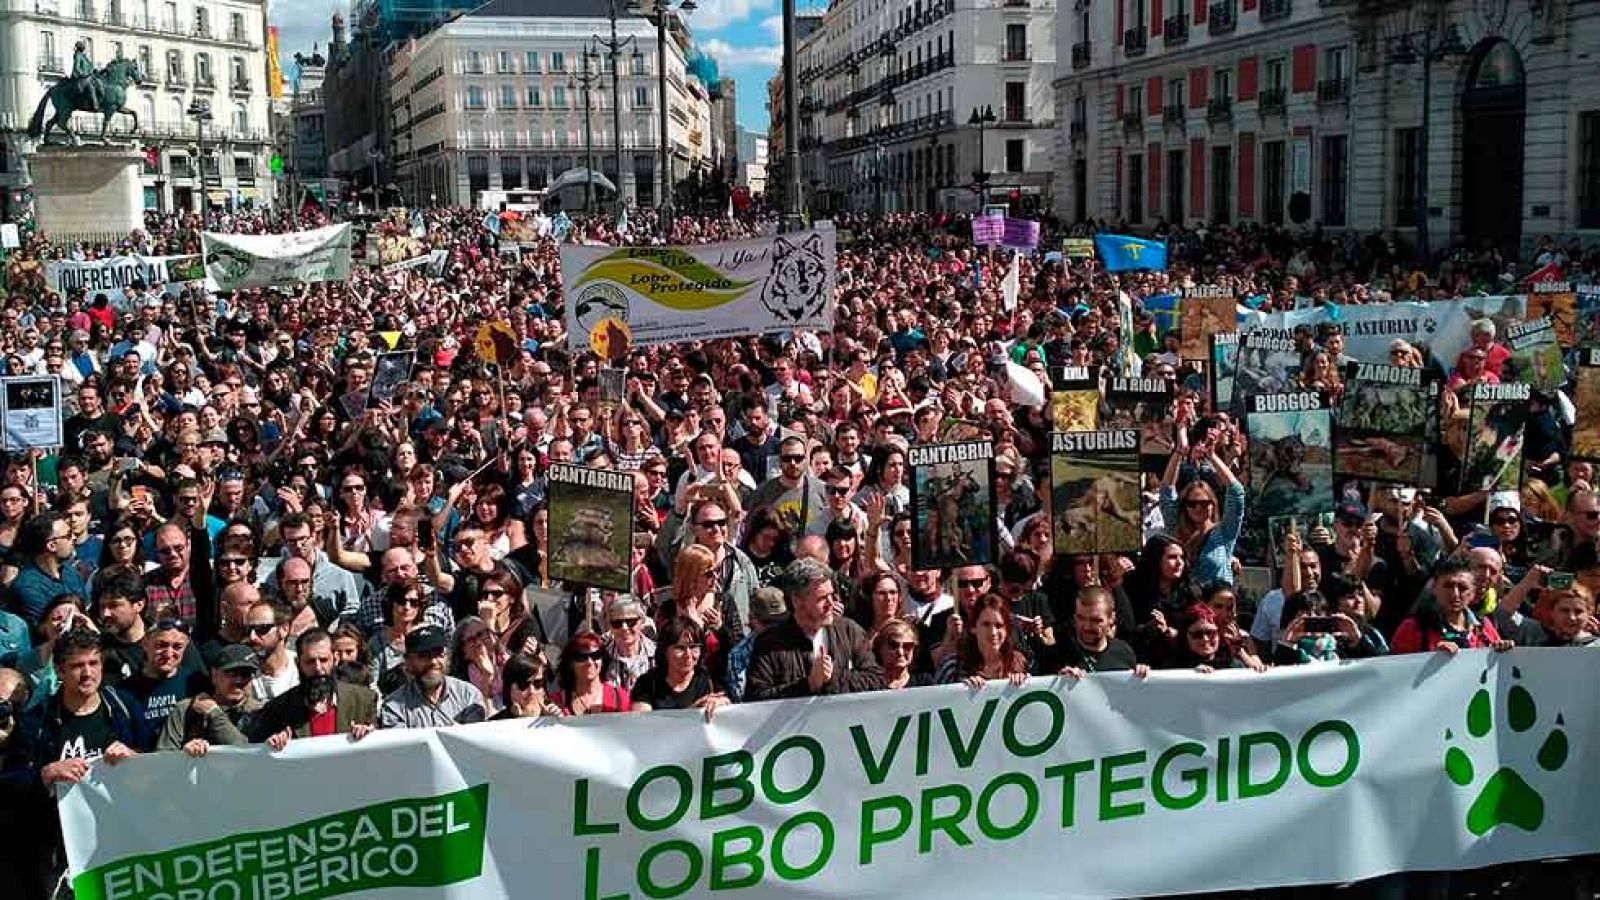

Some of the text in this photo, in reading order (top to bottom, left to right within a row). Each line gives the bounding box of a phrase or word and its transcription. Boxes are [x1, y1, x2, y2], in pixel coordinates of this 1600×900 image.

[629, 273, 672, 285] Lobo
[649, 278, 732, 294] Protegido
[1355, 318, 1419, 337] ASTURIAS
[1246, 334, 1297, 352] BURGOS
[1357, 363, 1421, 385] ZAMORA
[1112, 377, 1167, 393] LA RIOJA
[1473, 382, 1531, 400] ASTURIAS
[1254, 391, 1321, 412] BURGOS
[1052, 430, 1137, 451] ASTURIAS
[908, 441, 994, 467] CANTABRIA
[549, 463, 633, 492] CANTABRIA
[573, 689, 1066, 836] LOBO VIVO
[583, 719, 1361, 900] LOBO PROTEGIDO
[104, 861, 164, 900] EN
[173, 815, 383, 886] DEFENSA
[391, 801, 471, 839] DEL
[251, 843, 419, 900] IBÉRICO
